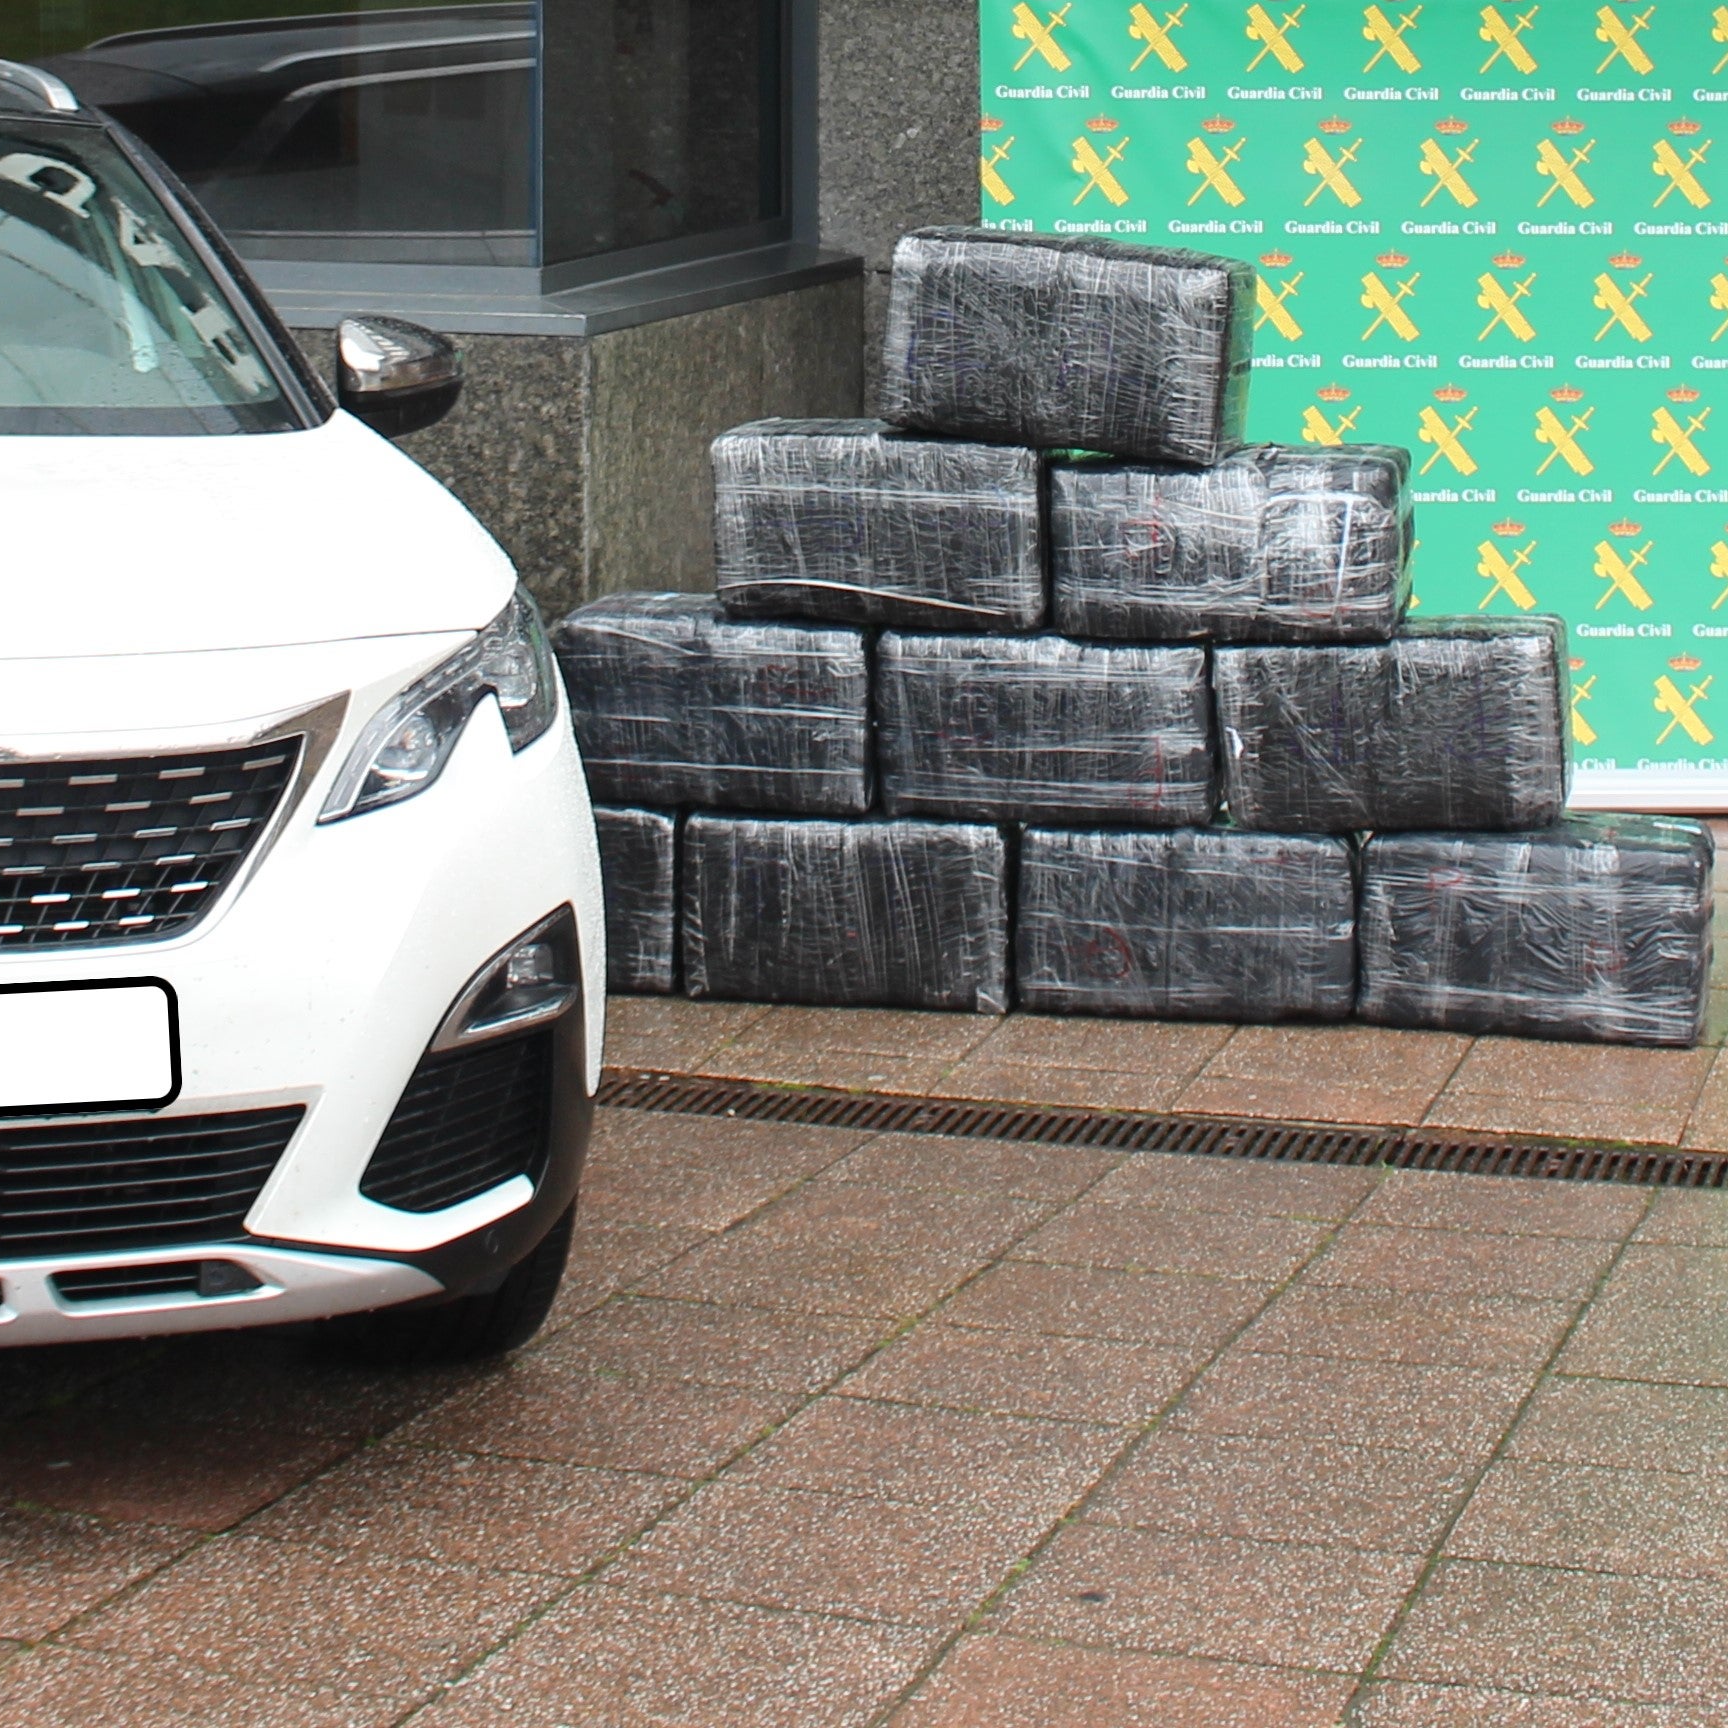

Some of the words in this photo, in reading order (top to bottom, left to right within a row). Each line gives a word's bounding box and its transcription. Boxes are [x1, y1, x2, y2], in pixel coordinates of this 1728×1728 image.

[995, 85, 1054, 99] Guardia
[1056, 85, 1090, 99] Civil
[1110, 85, 1169, 99] Guardia
[1172, 85, 1206, 99] Civil
[1227, 86, 1286, 100] Guardia
[1289, 86, 1323, 100] Civil
[1343, 87, 1402, 101] Guardia
[1406, 87, 1440, 101] Civil
[1460, 87, 1519, 101] Guardia
[1522, 87, 1556, 101] Civil
[1576, 88, 1635, 102] Guardia
[1638, 88, 1672, 102] Civil
[1000, 218, 1034, 233] Civil
[1053, 219, 1112, 234] Guardia
[1113, 219, 1147, 234] Civil
[1167, 219, 1226, 234] Guardia
[1230, 219, 1264, 234] Civil
[1284, 220, 1343, 234] Guardia
[1347, 220, 1381, 234] Civil
[1400, 220, 1459, 235] Guardia
[1463, 220, 1497, 235] Civil
[1517, 221, 1576, 235] Guardia
[1579, 221, 1613, 235] Civil
[1633, 221, 1692, 236] Guardia
[1288, 354, 1322, 368] Civil
[1342, 354, 1401, 369] Guardia
[1404, 354, 1438, 369] Civil
[1458, 354, 1517, 369] Guardia
[1521, 354, 1555, 369] Civil
[1574, 355, 1633, 369] Guardia
[1638, 355, 1672, 369] Civil
[1463, 488, 1497, 504] Civil
[1516, 489, 1575, 503] Guardia
[1579, 489, 1613, 503] Civil
[1632, 489, 1691, 503] Guardia
[1575, 623, 1634, 638] Guardia
[1639, 623, 1673, 638] Civil
[1583, 757, 1617, 770] Civil
[1636, 757, 1695, 770] Guardia
